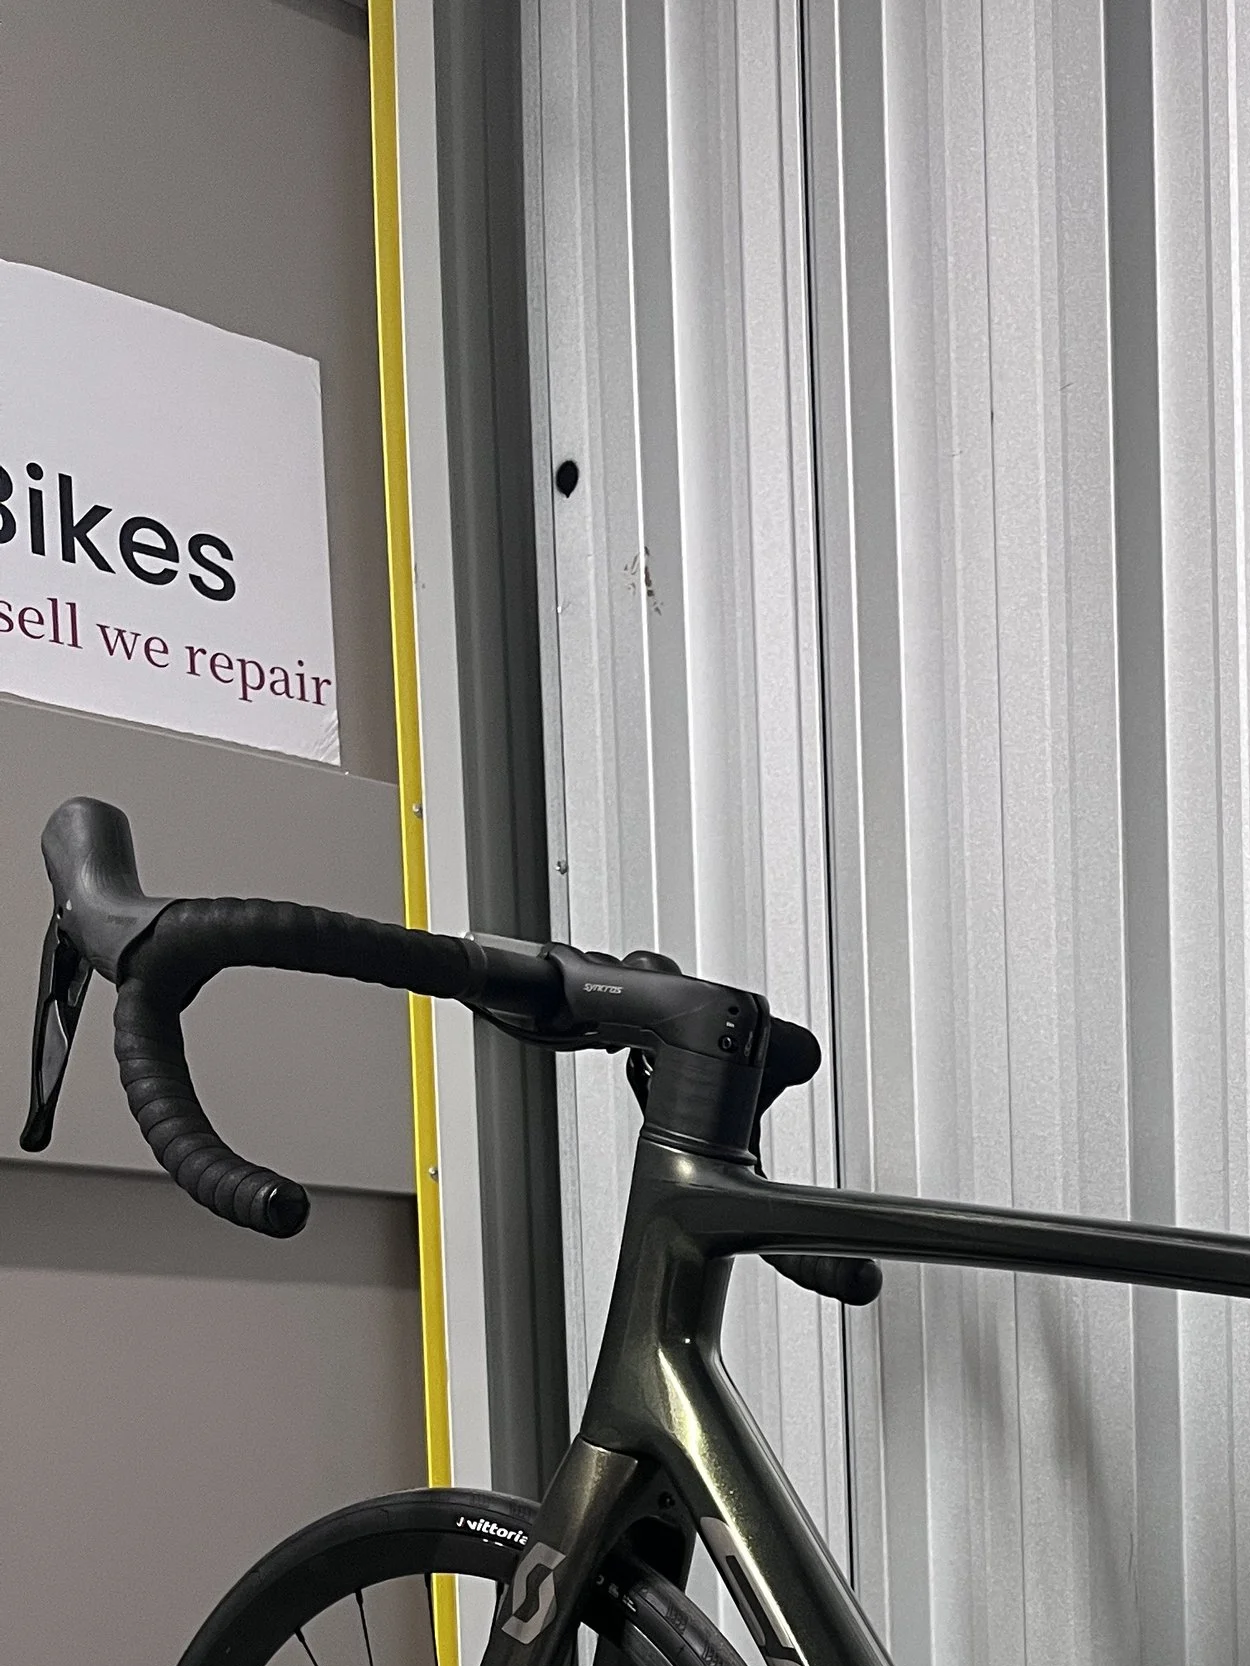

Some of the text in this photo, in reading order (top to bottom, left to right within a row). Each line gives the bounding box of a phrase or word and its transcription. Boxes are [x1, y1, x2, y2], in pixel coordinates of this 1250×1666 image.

[0, 597, 332, 707] sell we repair
